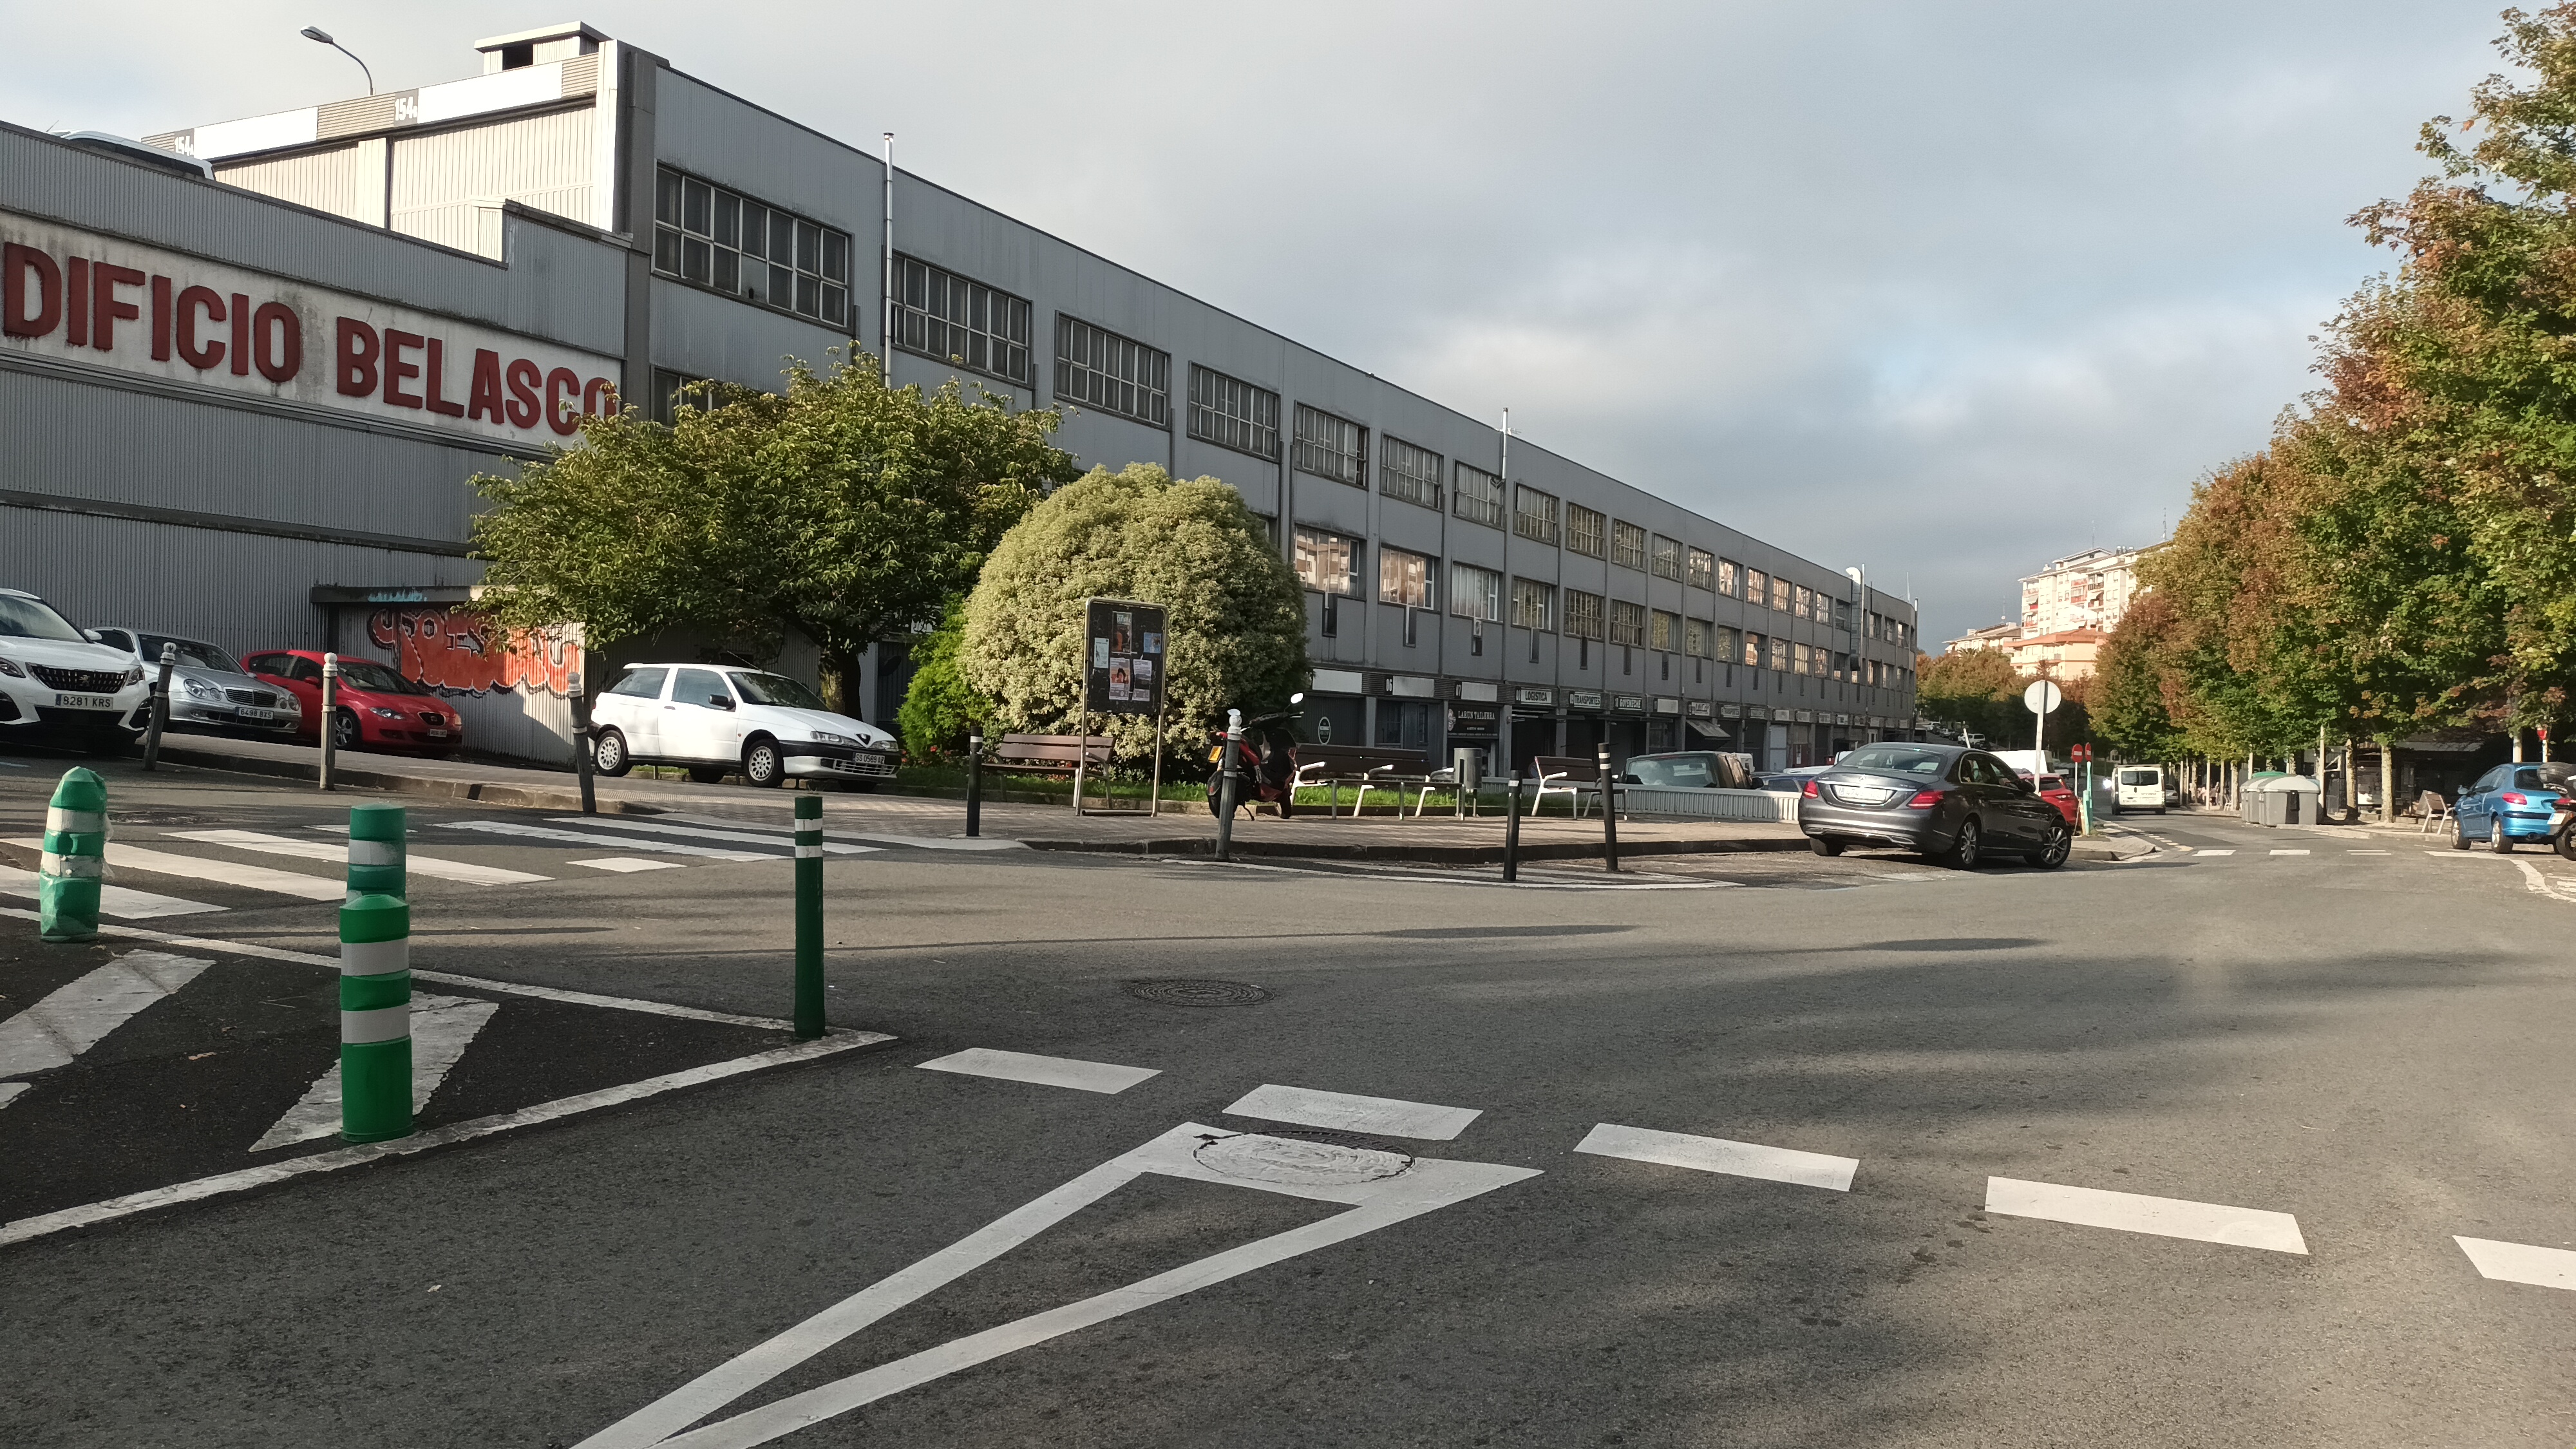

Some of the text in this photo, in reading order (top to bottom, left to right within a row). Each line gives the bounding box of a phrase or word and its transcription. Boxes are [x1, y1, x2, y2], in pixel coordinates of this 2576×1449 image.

[3, 242, 617, 435] DIFICIO BELASCO
[63, 696, 111, 708] 8281 KRS
[1575, 694, 1600, 705] TRANSPORTES
[240, 708, 258, 717] 6498
[856, 753, 863, 762] SS
